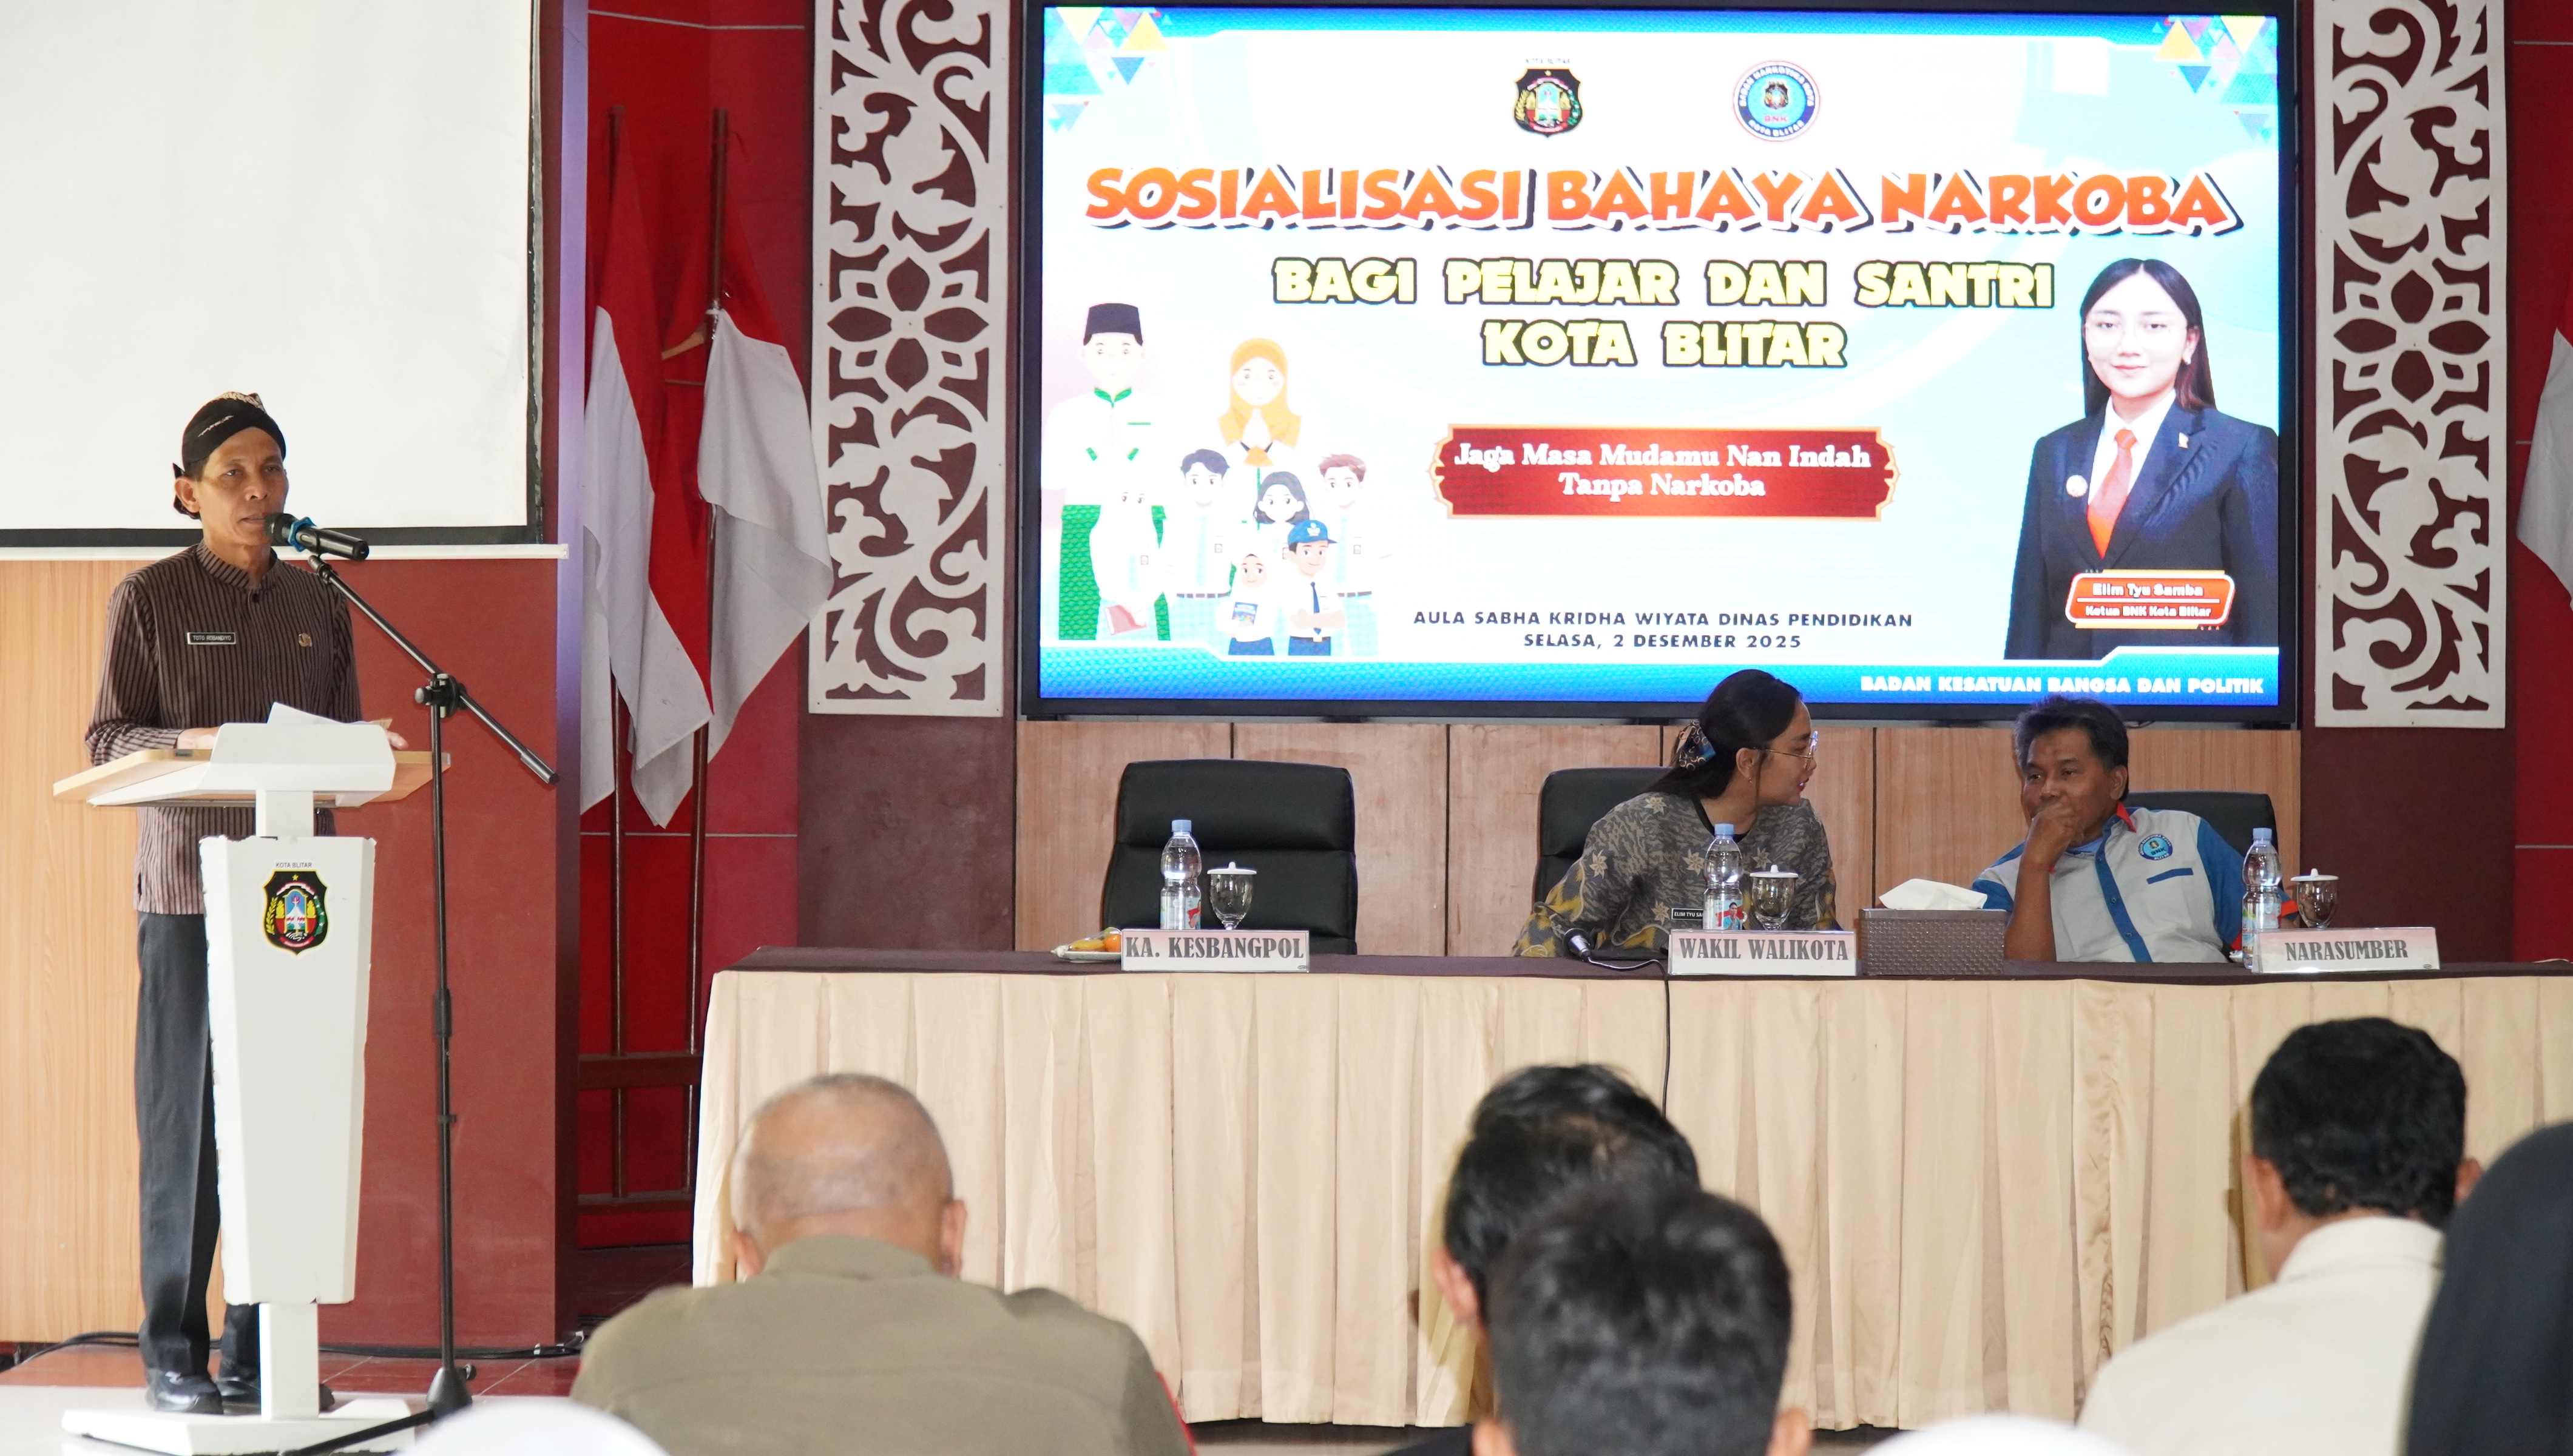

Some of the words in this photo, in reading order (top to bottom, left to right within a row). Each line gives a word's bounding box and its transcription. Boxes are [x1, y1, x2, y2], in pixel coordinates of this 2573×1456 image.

[1084, 165, 1527, 224] SOSIALISASI
[1547, 166, 1865, 226] BAHAYA
[1880, 170, 2233, 229] NARKOBA
[1272, 257, 1417, 305] BAGI
[1443, 257, 1680, 305] PELAJAR
[1705, 260, 1827, 306] DAN
[1854, 260, 2055, 308] SANTRI
[1481, 319, 1638, 366] KOTA
[1662, 320, 1847, 368] BLITAR
[1454, 443, 1515, 473] Jaga
[1521, 443, 1593, 465] Masa
[1599, 443, 1720, 466] Mudamu
[1726, 445, 1782, 467] Nan
[1788, 445, 1871, 467] Indah
[1558, 472, 1644, 502] Tanpa
[1650, 473, 1766, 496] Narkoba
[2092, 583, 2125, 596] Elim
[2126, 583, 2151, 599] Tyu
[2153, 583, 2204, 597] Samba
[1413, 611, 1465, 624] AULA
[1474, 612, 1541, 625] SABHA
[1549, 612, 1626, 625] KRIDHA
[1635, 612, 1709, 626] WIYATA
[1719, 613, 1780, 626] DINAS
[1788, 613, 1912, 627] PENDIDIKAN
[2084, 605, 2120, 616] Ketua
[2122, 605, 2148, 617] BNK
[2149, 605, 2177, 617] Kota
[2179, 605, 2212, 618] Blitar
[1524, 634, 1602, 650] SELASA,
[1613, 635, 1624, 647] 2
[1633, 635, 1736, 648] DESEMBER
[1746, 635, 1801, 649] 2025
[1861, 676, 1932, 692] BADAN
[1938, 676, 2042, 692] KESATUAN
[2047, 676, 2131, 693] BANGSA
[2137, 676, 2181, 693] DAN
[2187, 677, 2264, 693] POLITIK
[2150, 847, 2168, 855] BNK
[1125, 937, 1160, 958] KA.
[1168, 937, 1304, 959] KESBANGPOL
[1679, 938, 1741, 959] WAKIL
[1748, 939, 1848, 960] WALIKOTA
[2284, 939, 2409, 962] NARASUMBER
